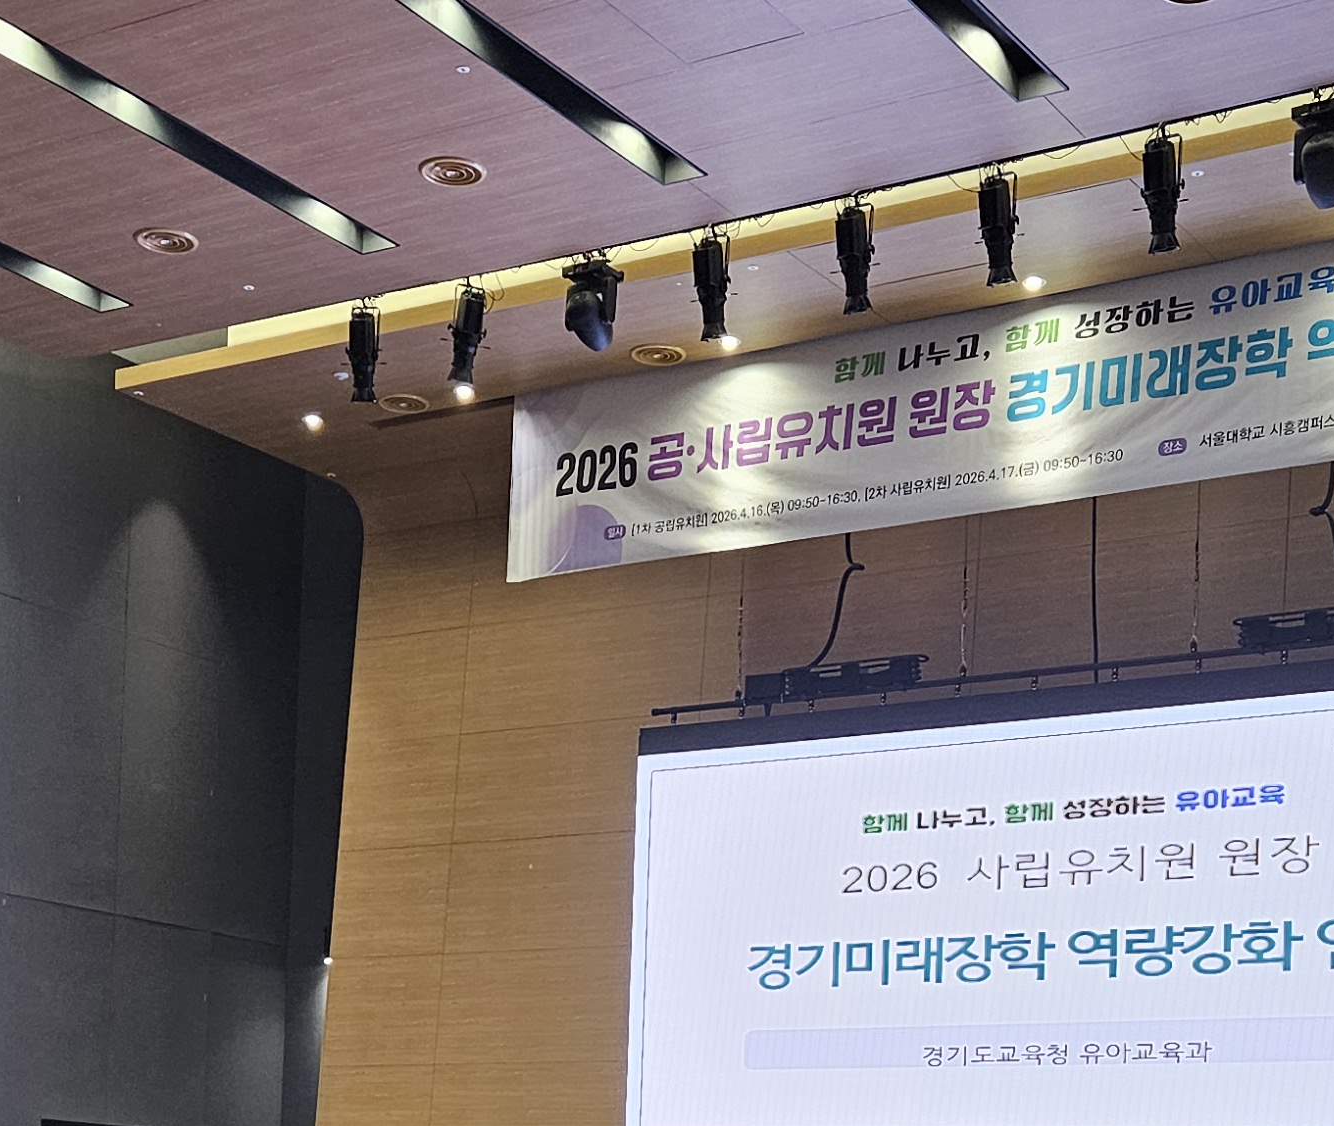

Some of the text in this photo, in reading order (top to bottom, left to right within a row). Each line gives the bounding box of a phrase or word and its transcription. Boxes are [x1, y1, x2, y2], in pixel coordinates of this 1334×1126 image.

[834, 351, 885, 384] 함께
[897, 333, 990, 372] 나누고,
[1005, 318, 1060, 353] 함께
[1074, 296, 1196, 340] 성장하는
[555, 442, 638, 498] 2026
[647, 396, 897, 482] 공·사립유치원
[909, 379, 996, 439] 원장
[1007, 325, 1294, 423] 경기미래장학
[1199, 425, 1265, 448] 서울대학교
[1163, 440, 1184, 454] 장소
[631, 523, 652, 537] [1차
[654, 512, 708, 534] 공립유치원]
[711, 502, 785, 524] 2026.4.16.(목)
[864, 484, 887, 502] [2차
[890, 475, 951, 497] 사립유치원]
[955, 460, 1040, 487] 2026.4.17.(금)
[1043, 449, 1124, 472] 09:50~16:30
[862, 783, 1286, 834] 함께 나누고, 함께 성장하는 유아교육
[841, 834, 1320, 894] 2026 사립유치원 원장
[747, 931, 1055, 990] 경기미래장학
[1067, 919, 1303, 979] 역량강화
[922, 1040, 1213, 1067] 경기도교육청 유아교육과
